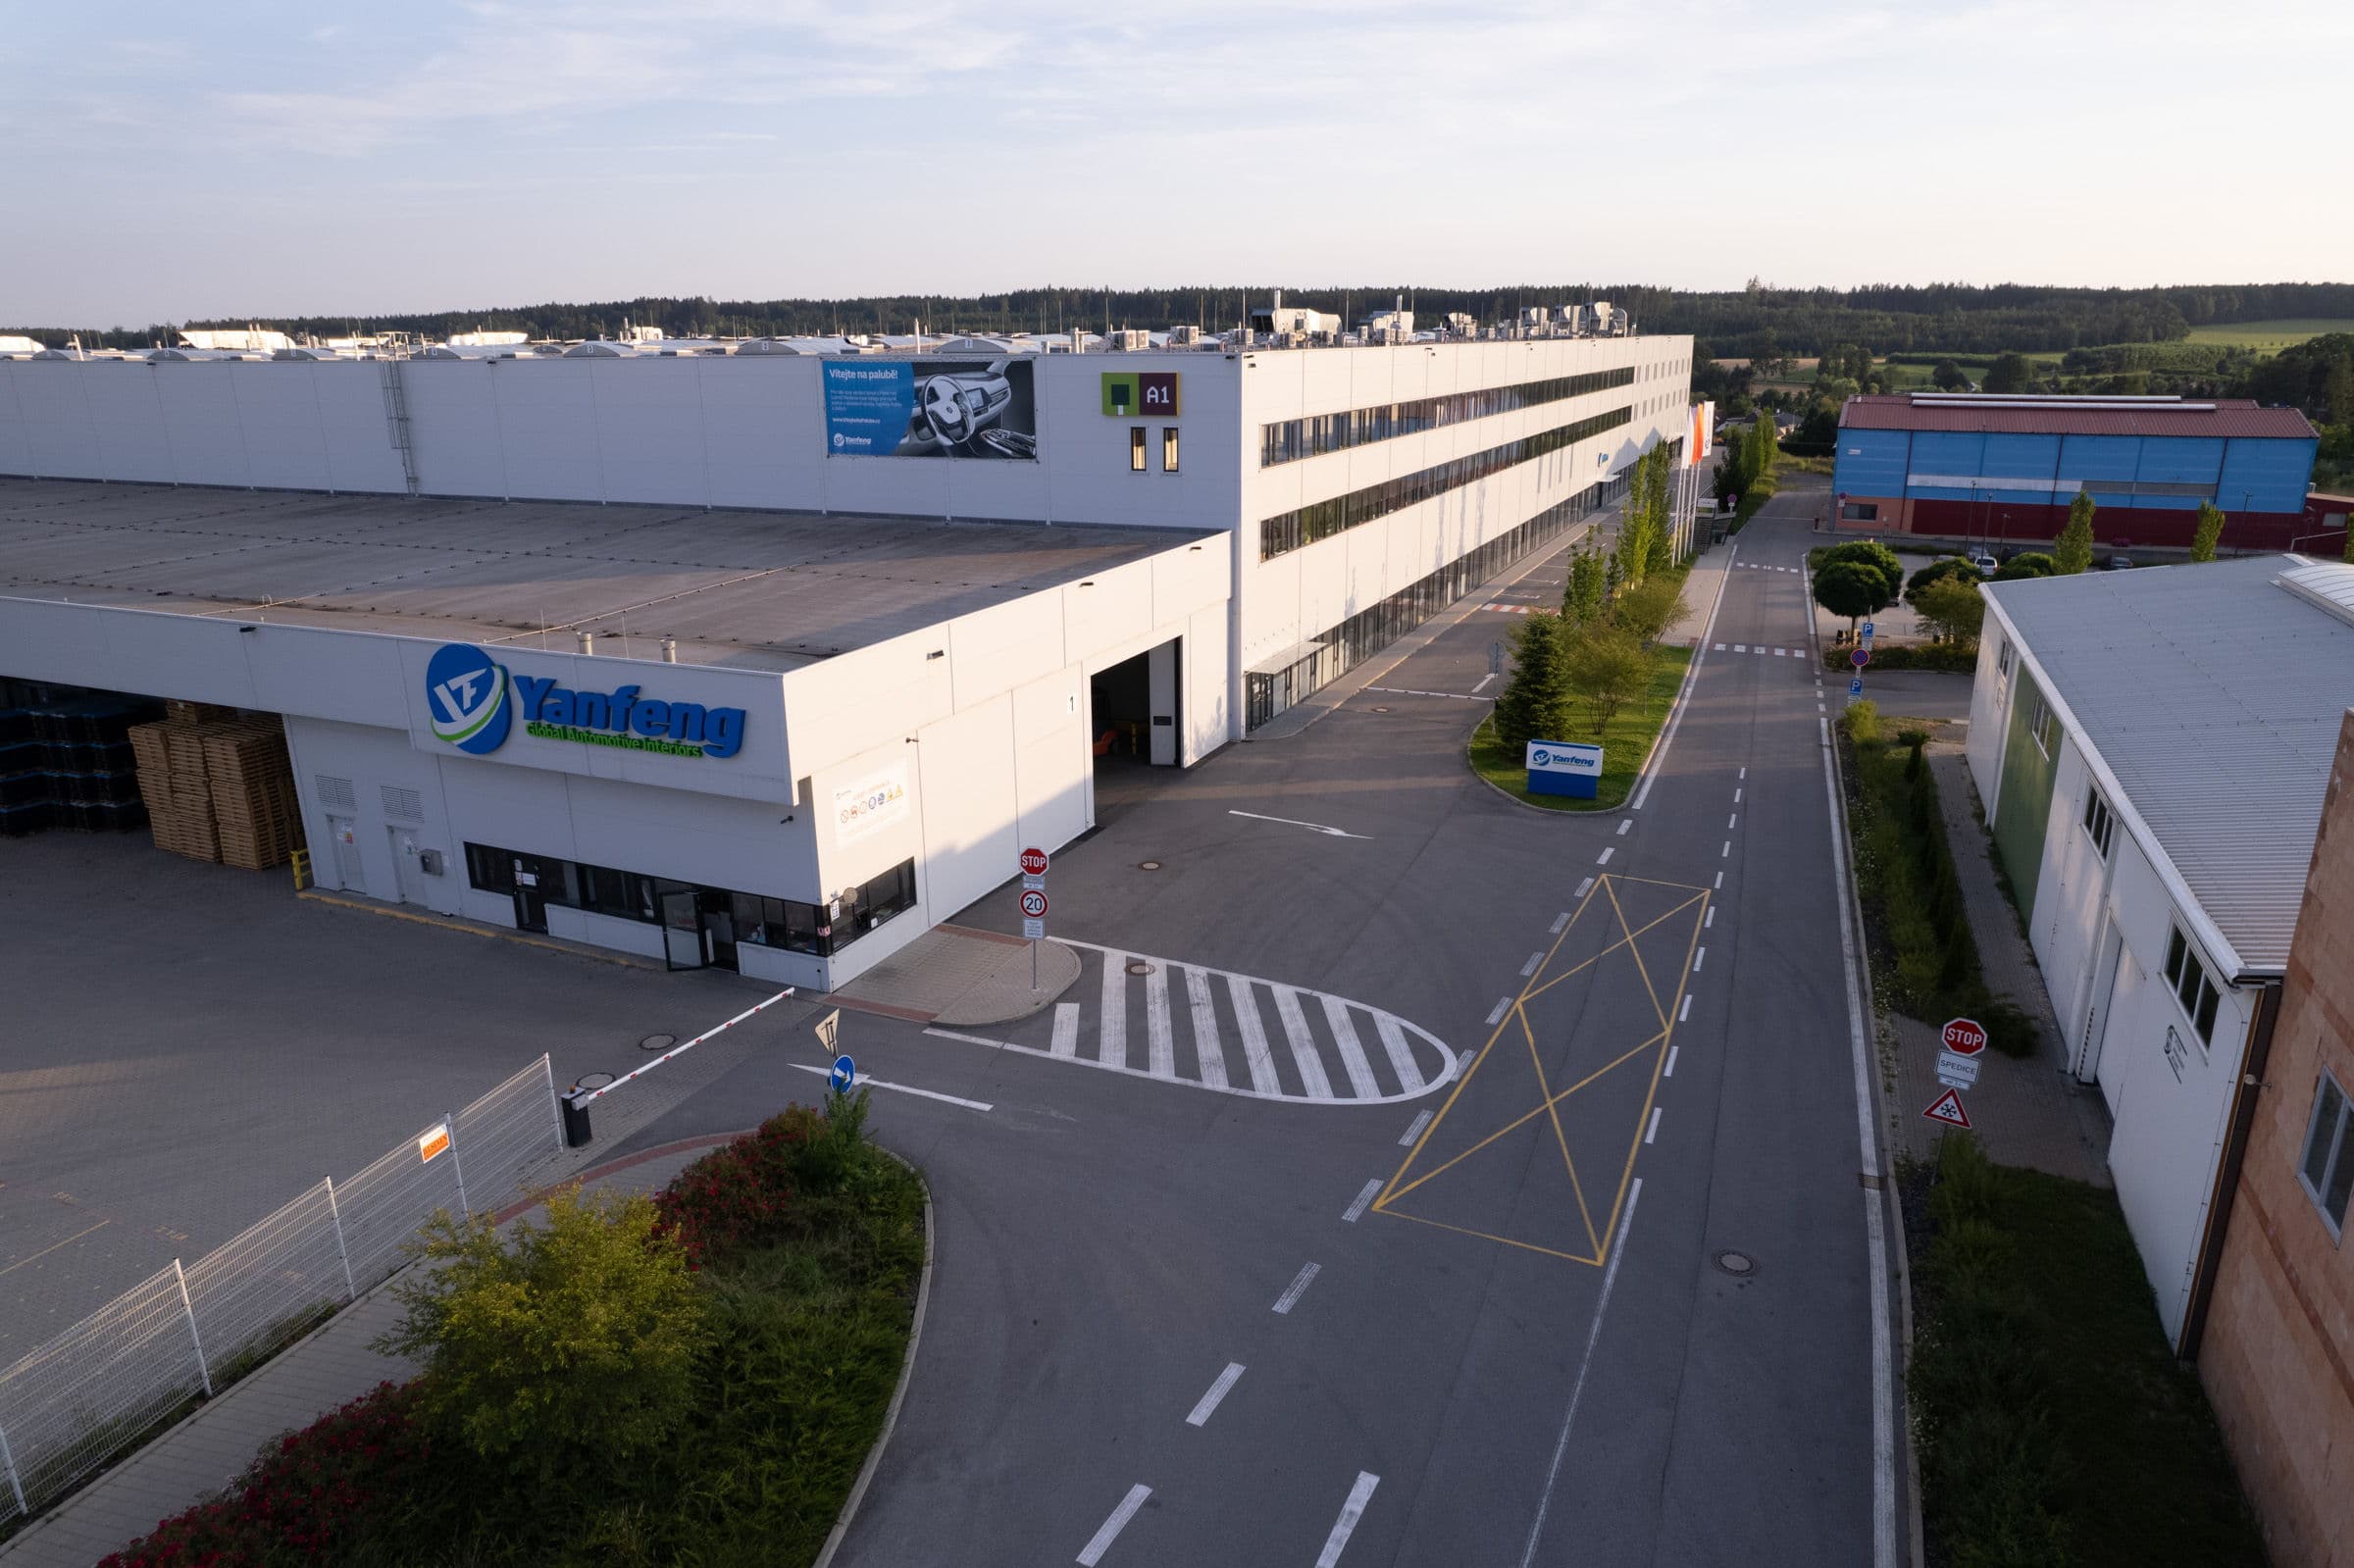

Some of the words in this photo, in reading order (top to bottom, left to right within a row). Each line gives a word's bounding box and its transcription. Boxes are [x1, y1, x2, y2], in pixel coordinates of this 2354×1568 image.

[856, 371, 867, 379] na
[868, 369, 898, 380] palubě!
[1147, 385, 1169, 403] A1
[845, 435, 871, 445] Yanfeng
[1852, 681, 1860, 690] P
[514, 676, 745, 758] Yanfeng
[526, 722, 565, 742] Global
[567, 728, 642, 751] Automotive
[641, 737, 704, 758] Interiors
[1553, 754, 1594, 767] Yanfeng
[1022, 856, 1046, 868] STOP
[1026, 897, 1042, 911] 20
[1947, 1028, 1982, 1046] STOP
[1940, 1060, 1976, 1075] SPEDICE
